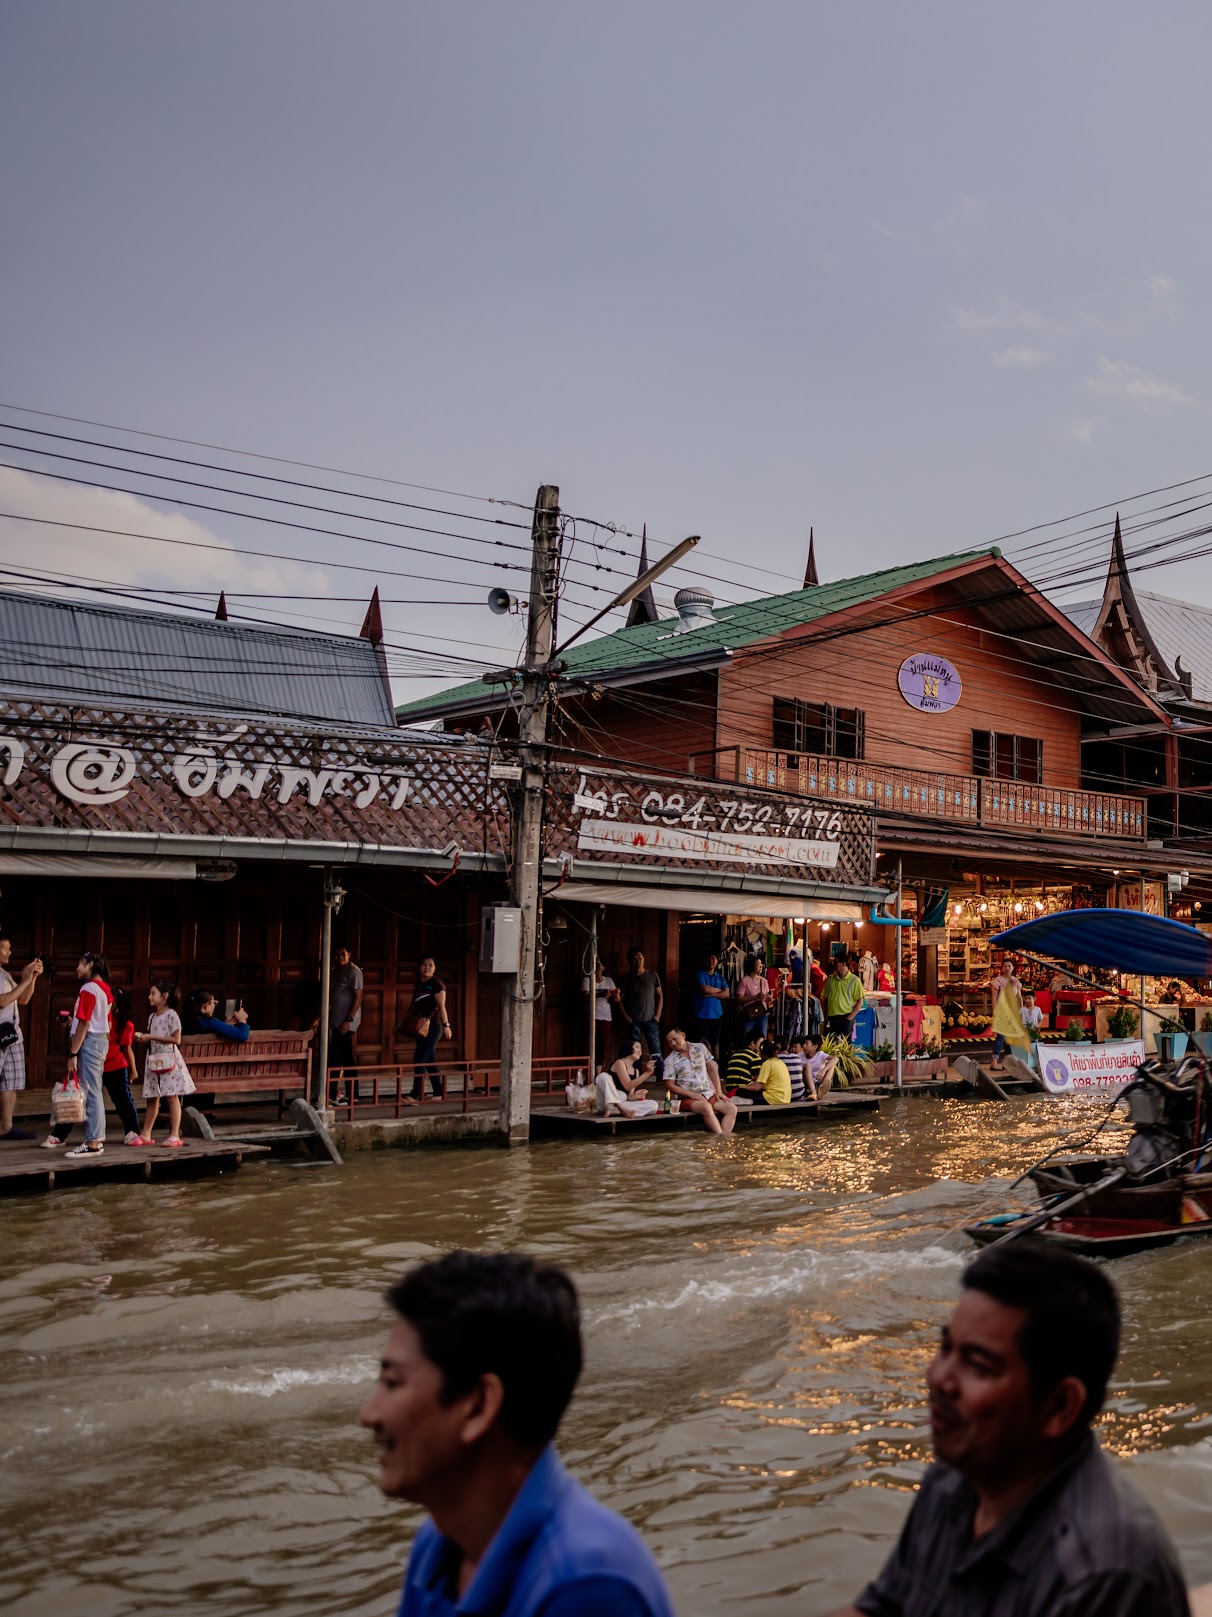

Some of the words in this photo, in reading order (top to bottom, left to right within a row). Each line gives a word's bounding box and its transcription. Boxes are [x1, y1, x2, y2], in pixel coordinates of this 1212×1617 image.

[51, 739, 136, 805] @
[173, 724, 410, 811] อัมพวา
[641, 790, 841, 840] 084-752-7176
[1067, 1050, 1141, 1071] ให้เช่าพื้นที่ขายสินค้า
